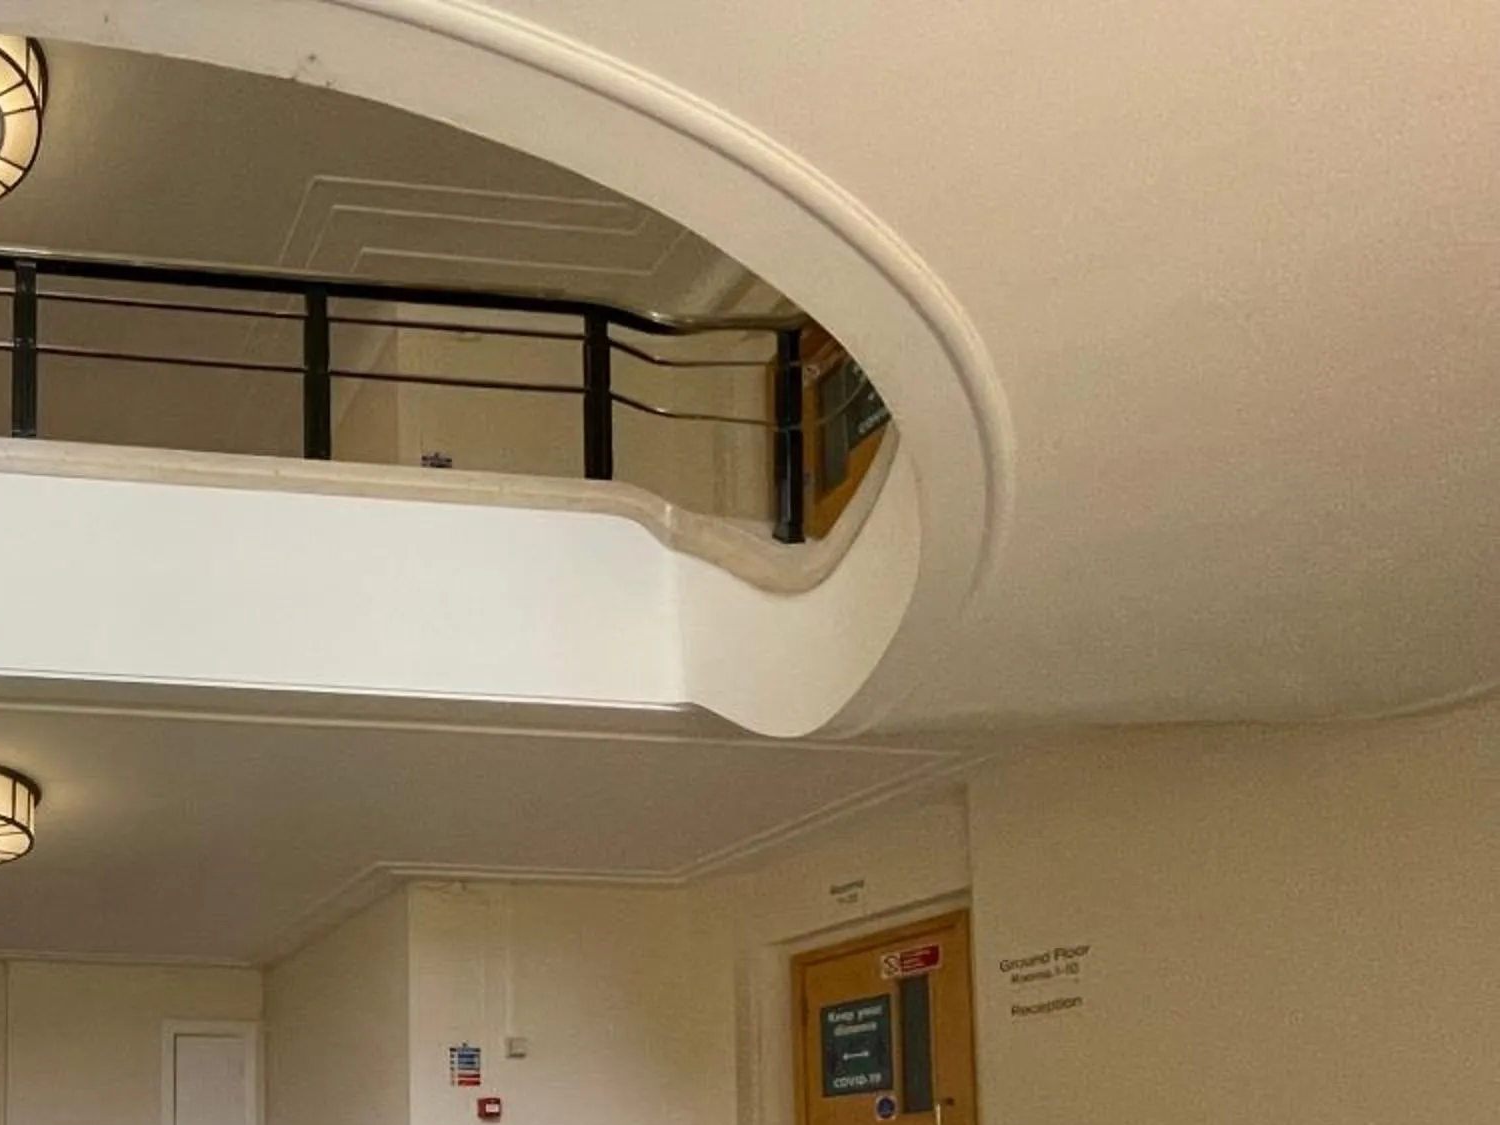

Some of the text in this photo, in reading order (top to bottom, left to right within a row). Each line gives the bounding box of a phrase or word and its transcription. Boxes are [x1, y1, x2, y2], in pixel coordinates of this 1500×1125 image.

[999, 945, 1090, 973] Ground Floor
[1011, 996, 1083, 1017] Reception
